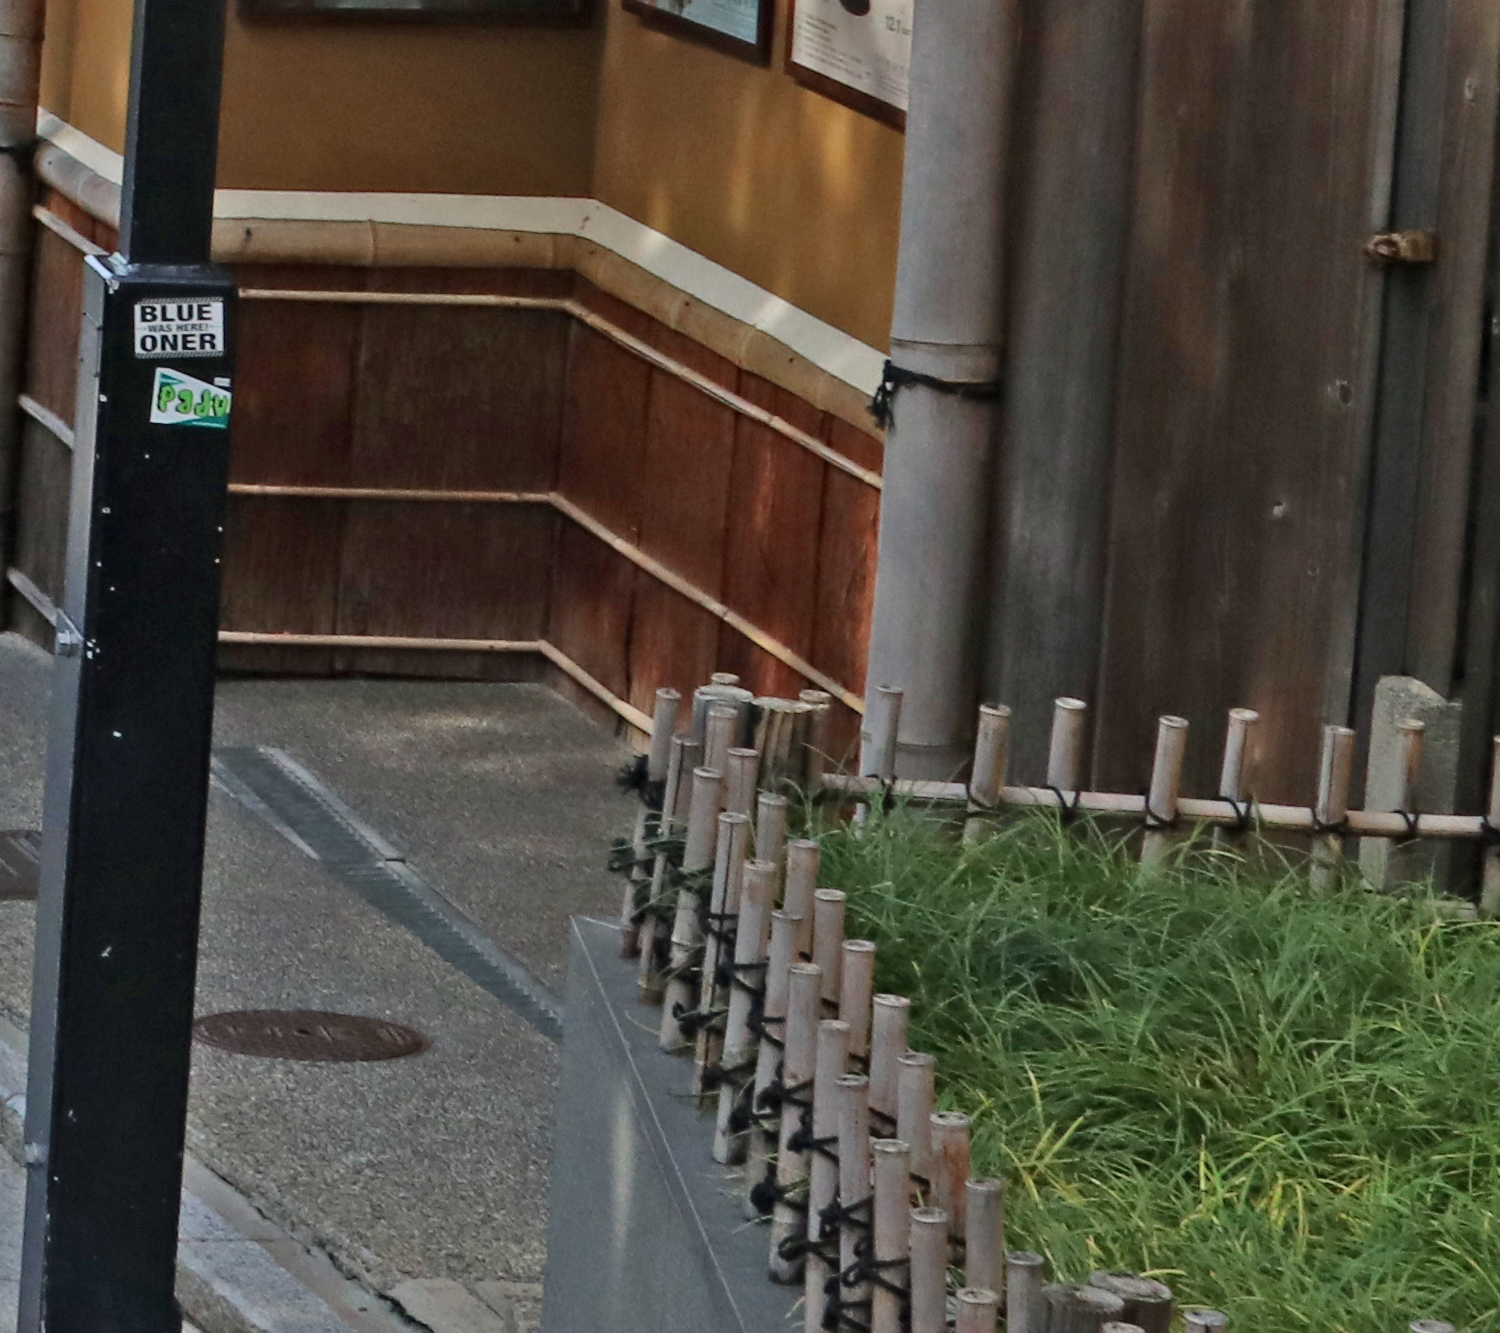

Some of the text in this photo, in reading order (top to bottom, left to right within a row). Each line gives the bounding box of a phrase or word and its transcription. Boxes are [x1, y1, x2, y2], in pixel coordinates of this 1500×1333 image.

[139, 304, 213, 323] BLUE
[148, 324, 172, 333] WAS
[139, 333, 217, 353] ONER
